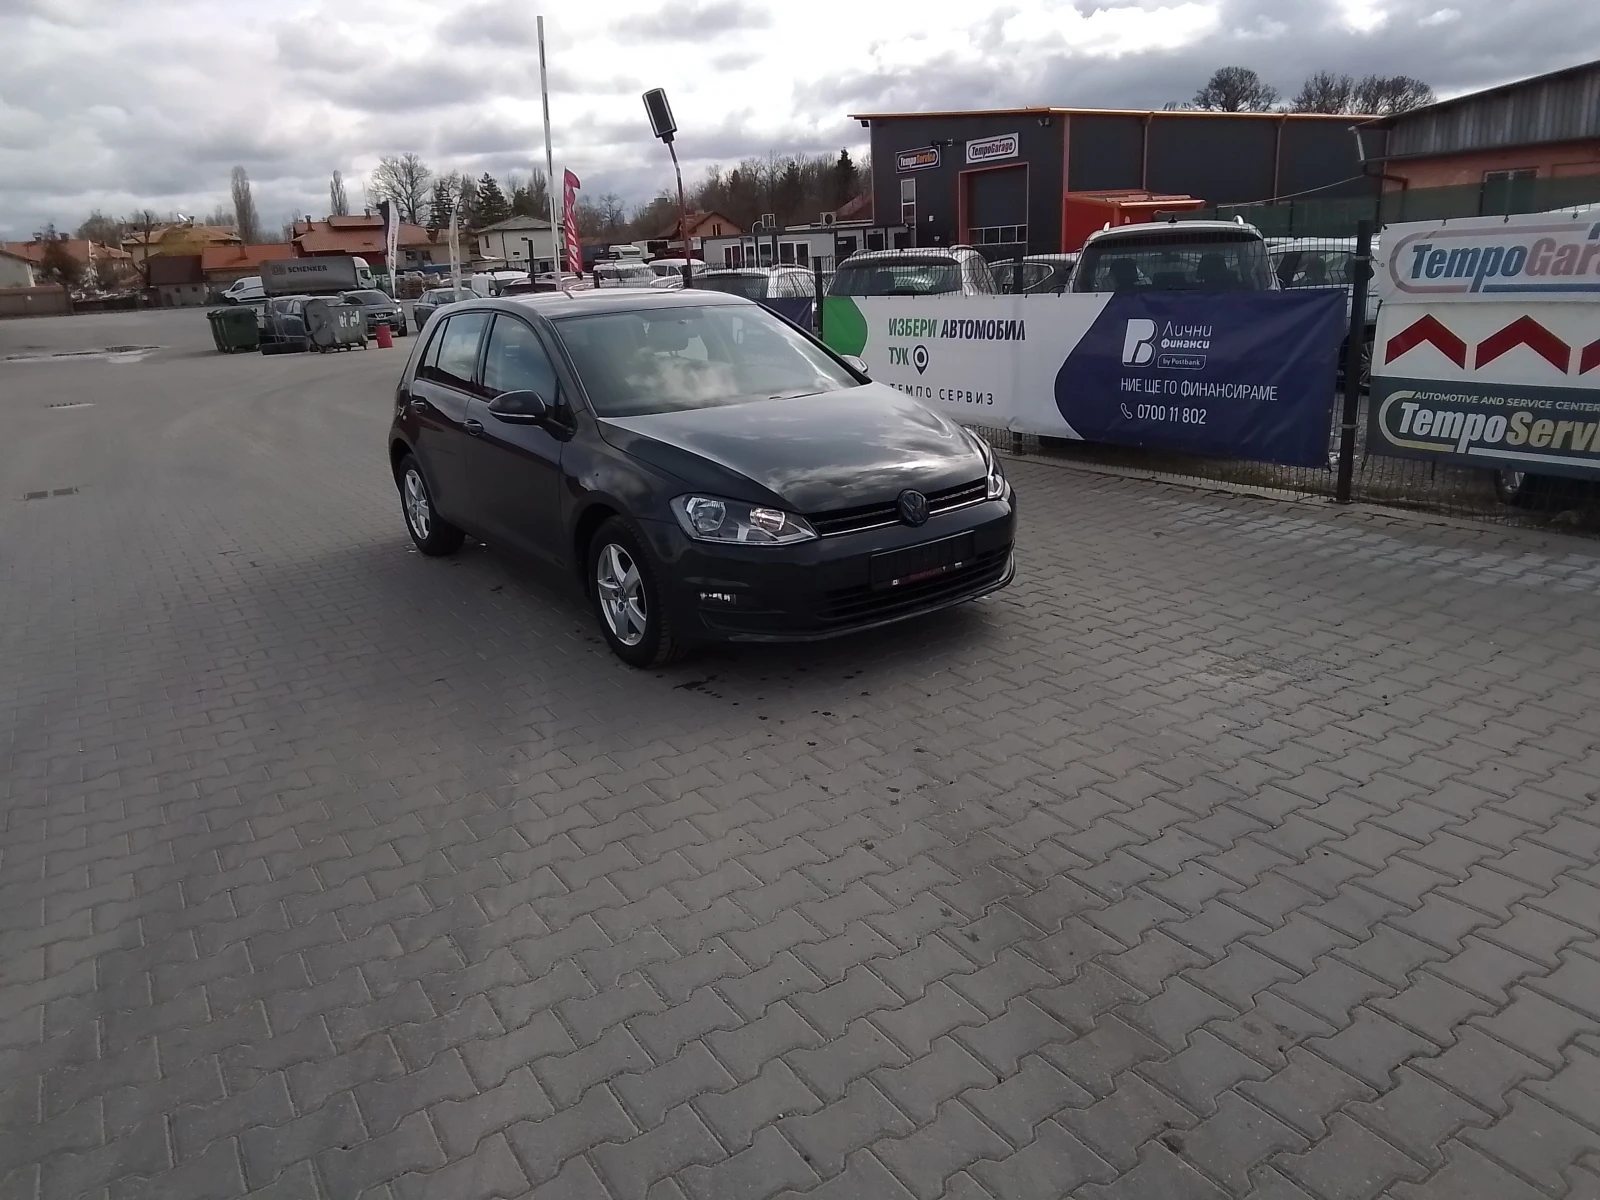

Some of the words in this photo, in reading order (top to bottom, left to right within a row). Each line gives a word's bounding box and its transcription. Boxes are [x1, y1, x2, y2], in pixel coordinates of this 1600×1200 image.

[971, 141, 1014, 158] TempoGarage
[900, 152, 936, 168] TempoService
[287, 265, 328, 273] SCHENKER
[1410, 237, 1600, 293] TempoGar
[888, 318, 938, 338] ИЗБЕРИ
[940, 319, 1026, 341] АВТОМОБИЛ
[1162, 320, 1213, 337] Лични
[1160, 338, 1210, 349] Финанси
[888, 346, 910, 366] ТУК
[1163, 358, 1170, 366] by
[1171, 358, 1201, 366] Postbank
[939, 388, 994, 406] СЕРВИЗ
[1120, 378, 1142, 392] НИЕ
[1144, 379, 1162, 395] ЩЕ
[1163, 380, 1178, 395] ГО
[1180, 380, 1278, 401] ФИНАНСИРАМЕ
[1413, 391, 1479, 405] AUTOMOTIVE
[1480, 394, 1505, 406] AND
[1506, 397, 1554, 409] SERVICE
[1137, 404, 1166, 421] 0700
[1169, 406, 1179, 422] 11
[1181, 407, 1207, 425] 802
